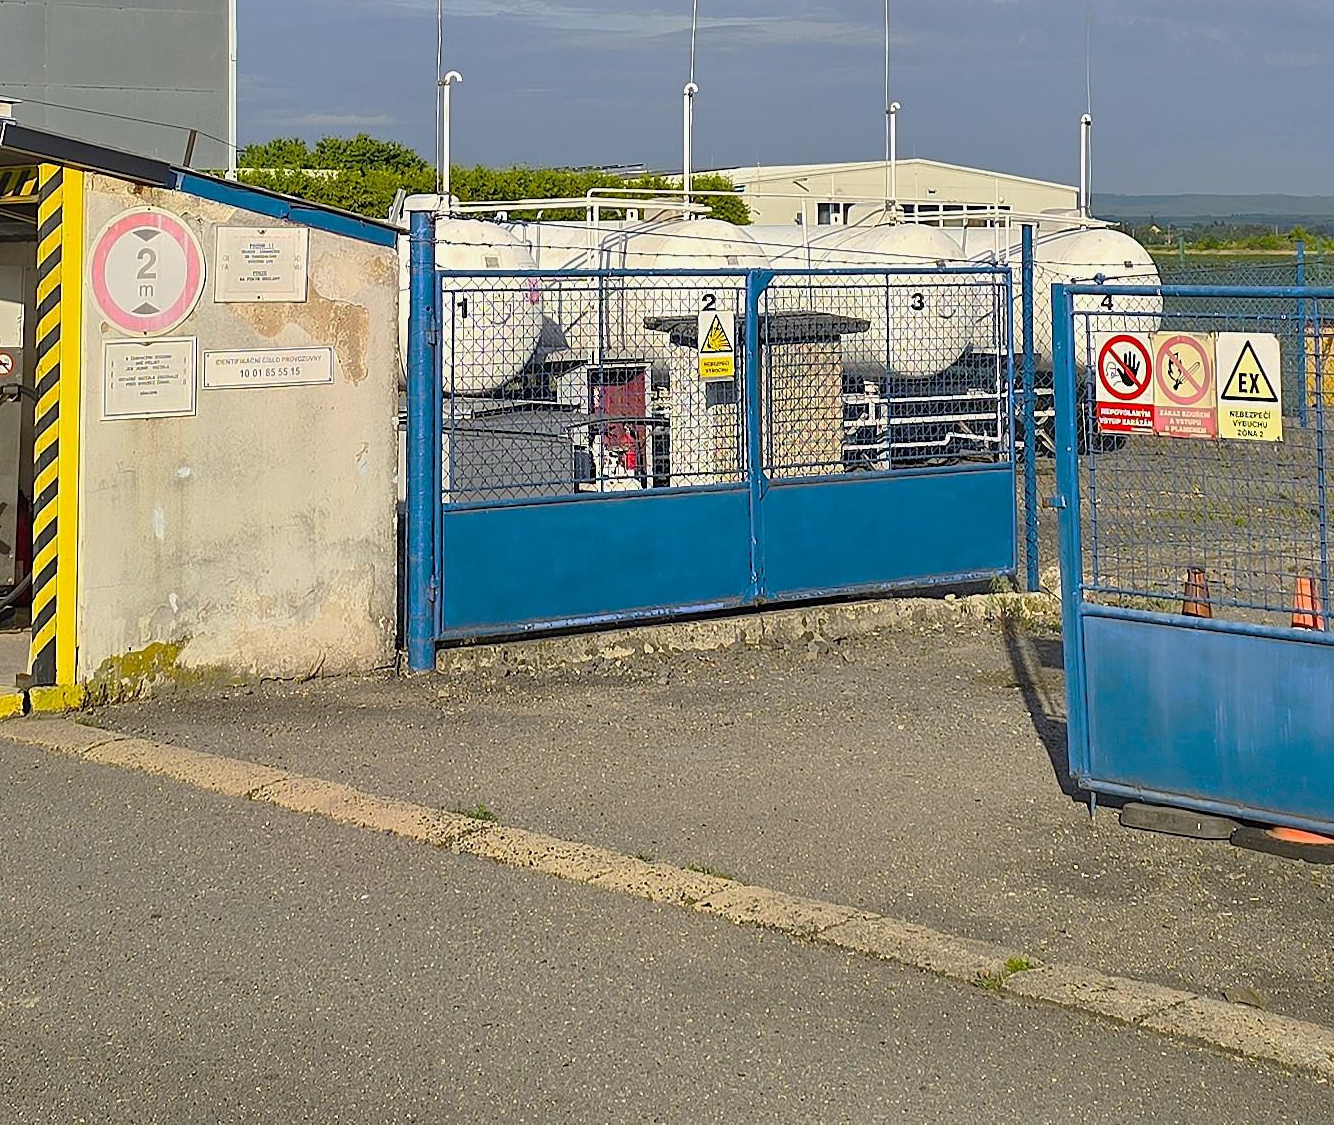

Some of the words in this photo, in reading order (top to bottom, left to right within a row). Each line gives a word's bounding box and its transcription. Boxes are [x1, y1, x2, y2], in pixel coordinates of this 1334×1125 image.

[137, 248, 157, 279] 2
[139, 284, 154, 297] m
[702, 294, 716, 311] 2
[911, 293, 925, 310] 3
[1101, 295, 1113, 310] 4
[457, 298, 467, 318] 1
[262, 355, 280, 363] ČÍSLO
[240, 369, 249, 378] 10
[252, 368, 262, 377] 01
[278, 368, 288, 376] 55
[291, 367, 301, 376] 15
[1238, 373, 1260, 394] EX
[1100, 407, 1151, 418] NEPOVOLANÝM
[1229, 410, 1271, 420] NEBEZPEČÍ
[1099, 417, 1121, 425] VSTUP
[1122, 417, 1153, 427] ZAKÁZÁN
[1176, 418, 1201, 426] VSTUPU
[1232, 418, 1268, 428] VÝBUCHU
[1237, 428, 1258, 437] ZÓNA
